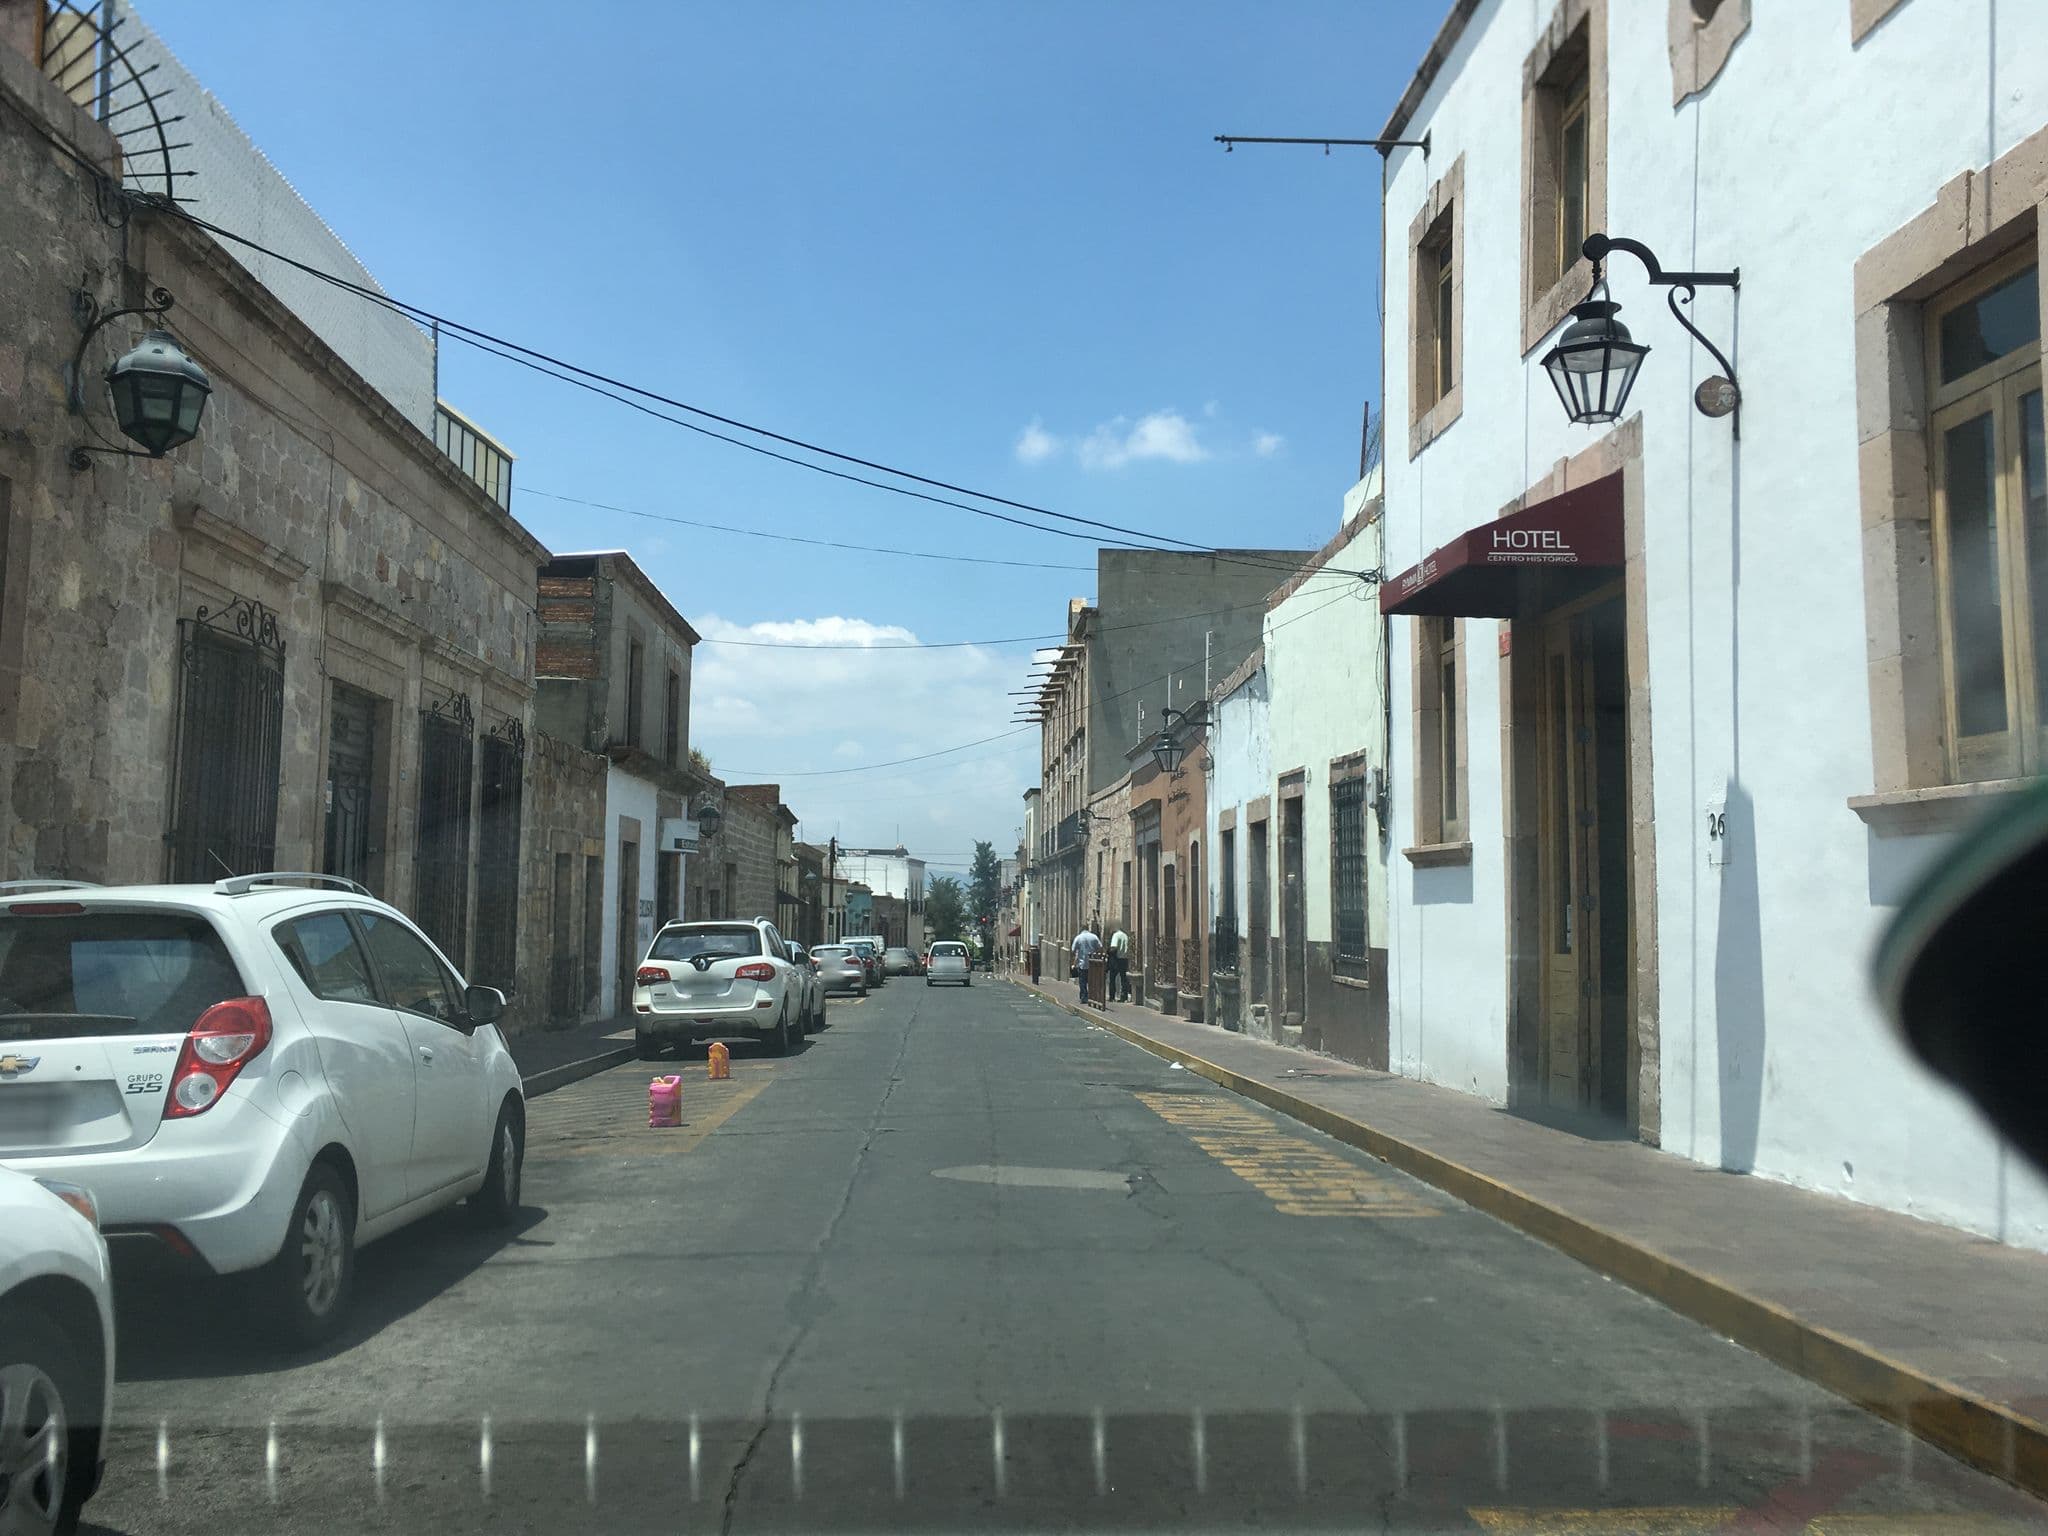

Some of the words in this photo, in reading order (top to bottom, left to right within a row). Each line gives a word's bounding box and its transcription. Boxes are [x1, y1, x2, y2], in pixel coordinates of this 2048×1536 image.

[1493, 530, 1570, 548] HOTEL
[1709, 813, 1727, 837] 26
[127, 1073, 163, 1082] GRUPO
